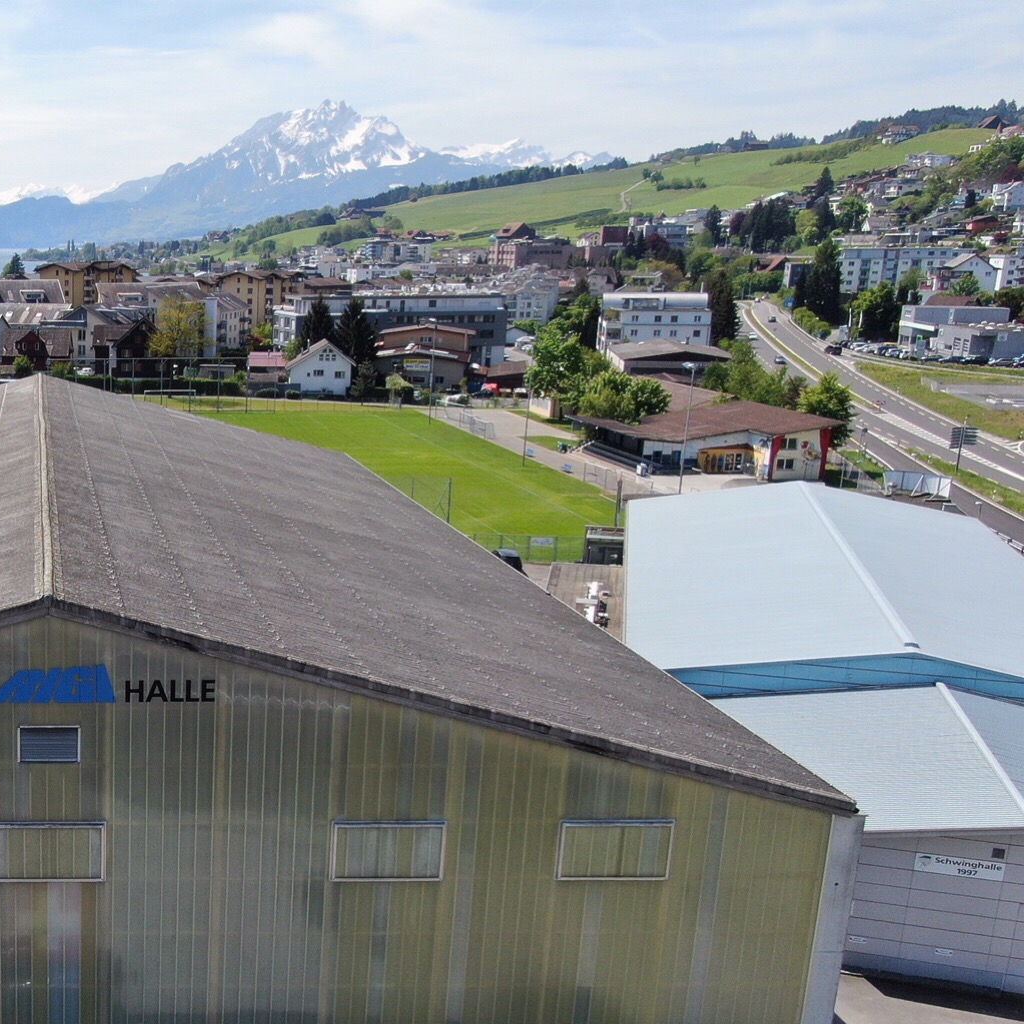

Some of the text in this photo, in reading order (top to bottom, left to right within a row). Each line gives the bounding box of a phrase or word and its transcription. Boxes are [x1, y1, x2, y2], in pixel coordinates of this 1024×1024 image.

[125, 679, 215, 703] HALLE
[935, 856, 1003, 872] Schwinghalle
[957, 868, 978, 876] 1997
